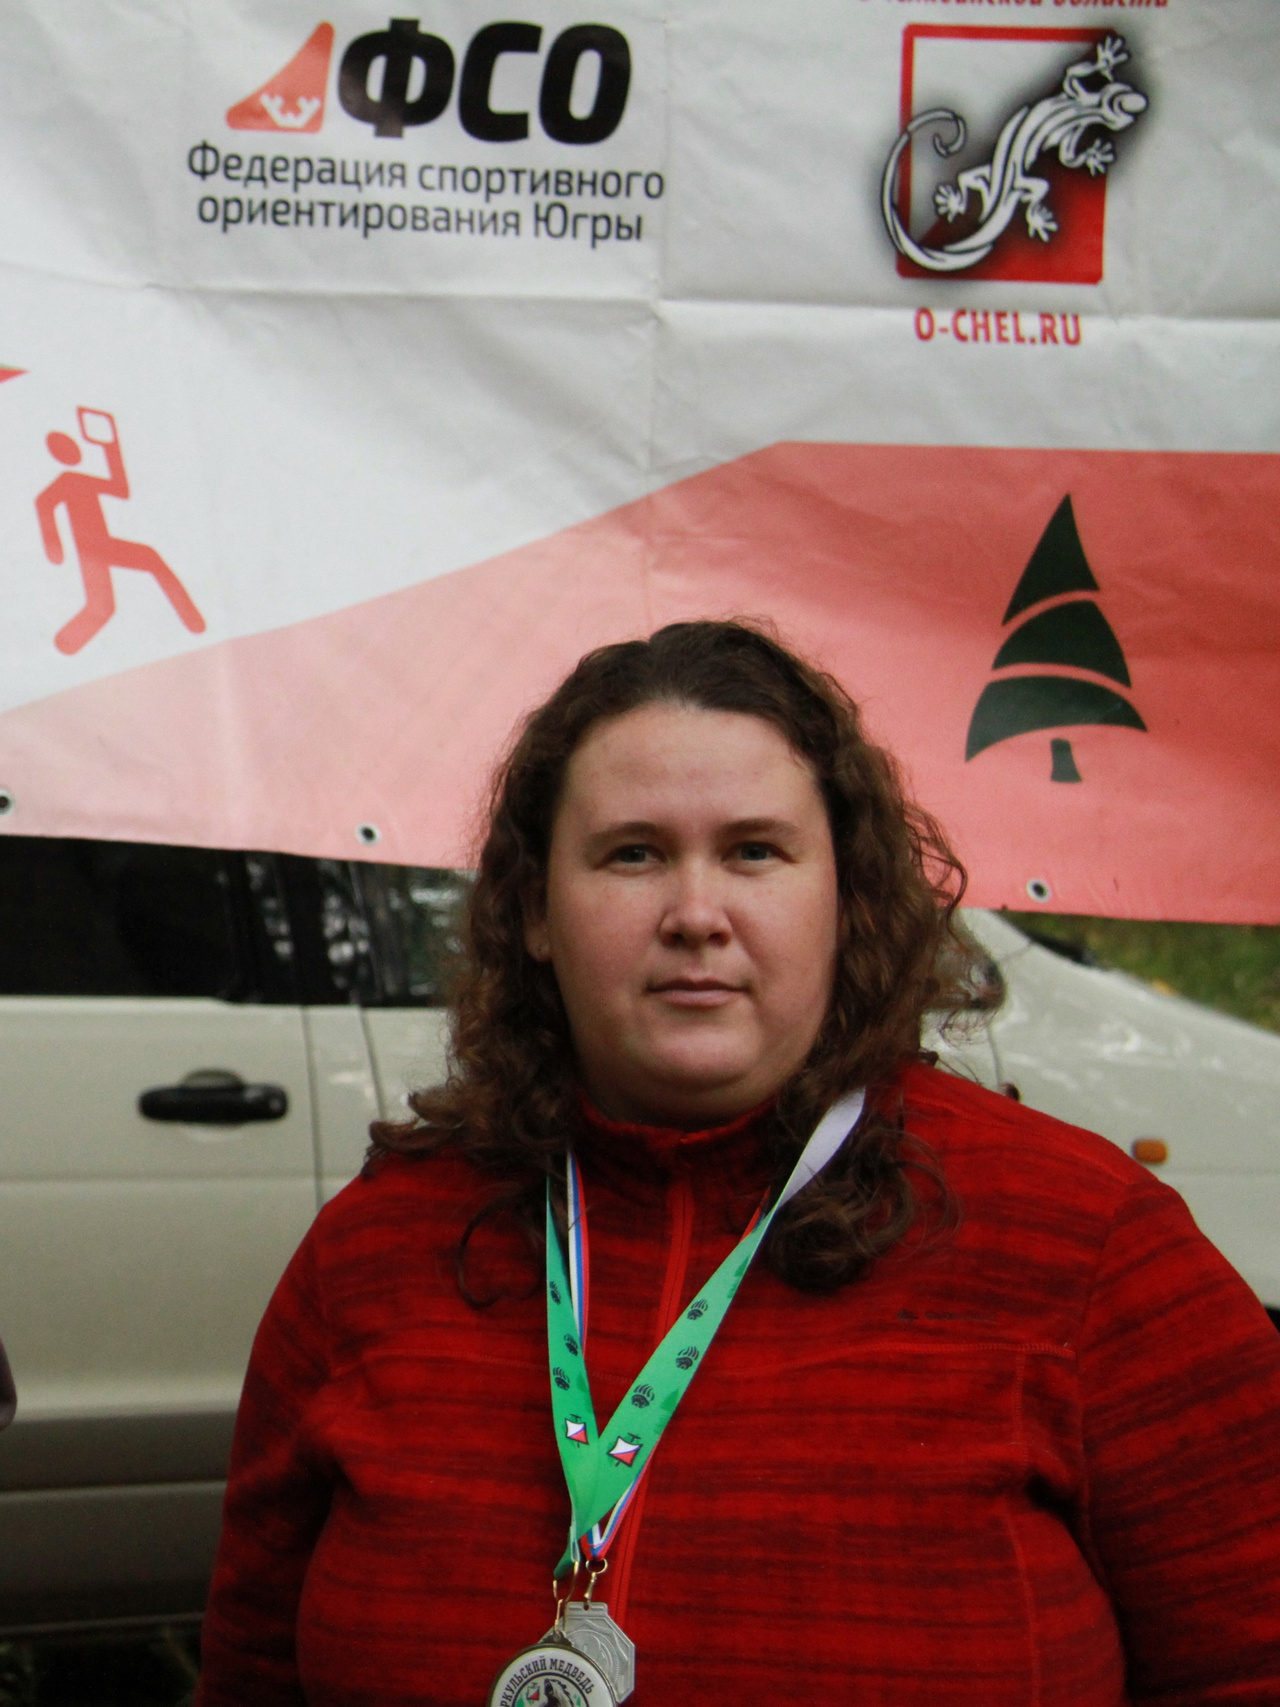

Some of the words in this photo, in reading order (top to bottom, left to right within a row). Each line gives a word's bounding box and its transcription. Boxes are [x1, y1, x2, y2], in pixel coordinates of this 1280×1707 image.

[337, 18, 631, 144] ФСО
[187, 140, 406, 193] Федерация
[419, 163, 664, 203] спортивного
[198, 196, 521, 239] ориентирования
[534, 202, 642, 249] Югры
[914, 307, 1081, 345] O-CHEL.RU
[549, 1658, 595, 1694] МЕДВЕДЬ
